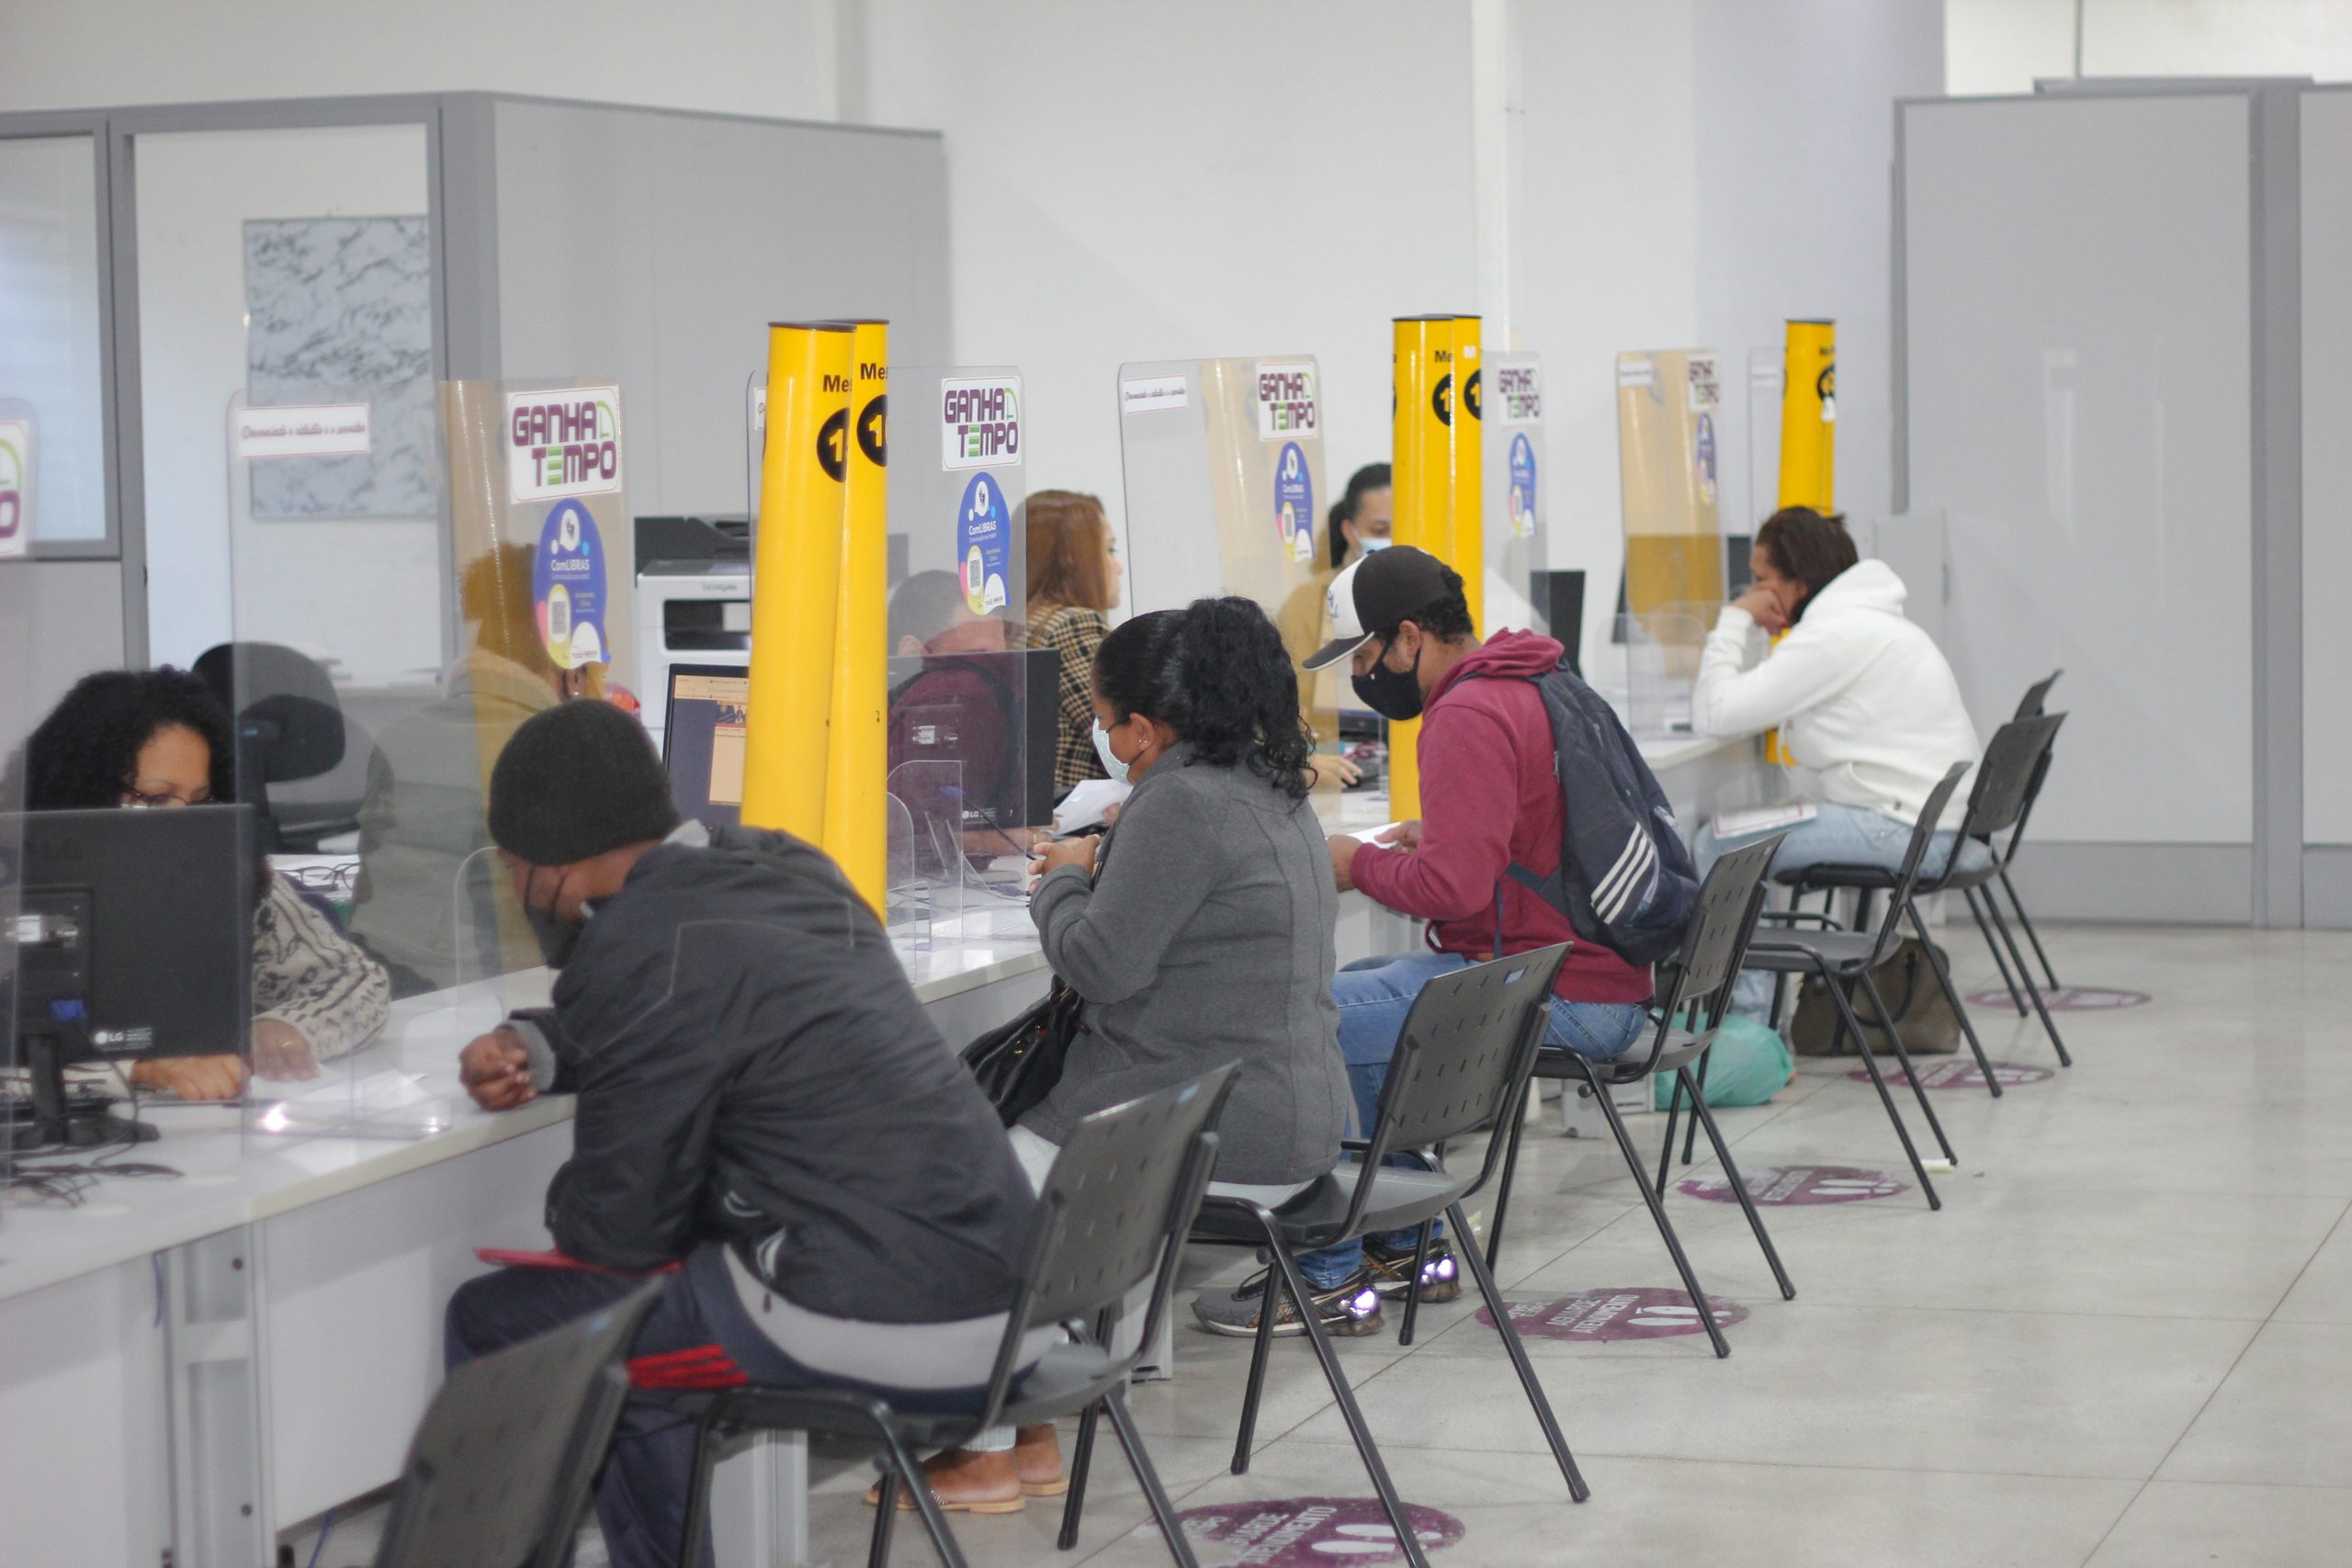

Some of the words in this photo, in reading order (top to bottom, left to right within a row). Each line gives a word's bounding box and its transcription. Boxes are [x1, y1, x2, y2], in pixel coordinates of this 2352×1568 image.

[1259, 372, 1304, 401] GANHA
[512, 400, 597, 446] GANHA
[944, 388, 1005, 423] GANHA
[1270, 401, 1315, 431] TEMPO
[957, 422, 1019, 458] TEMPO
[531, 441, 616, 487] TEMPO
